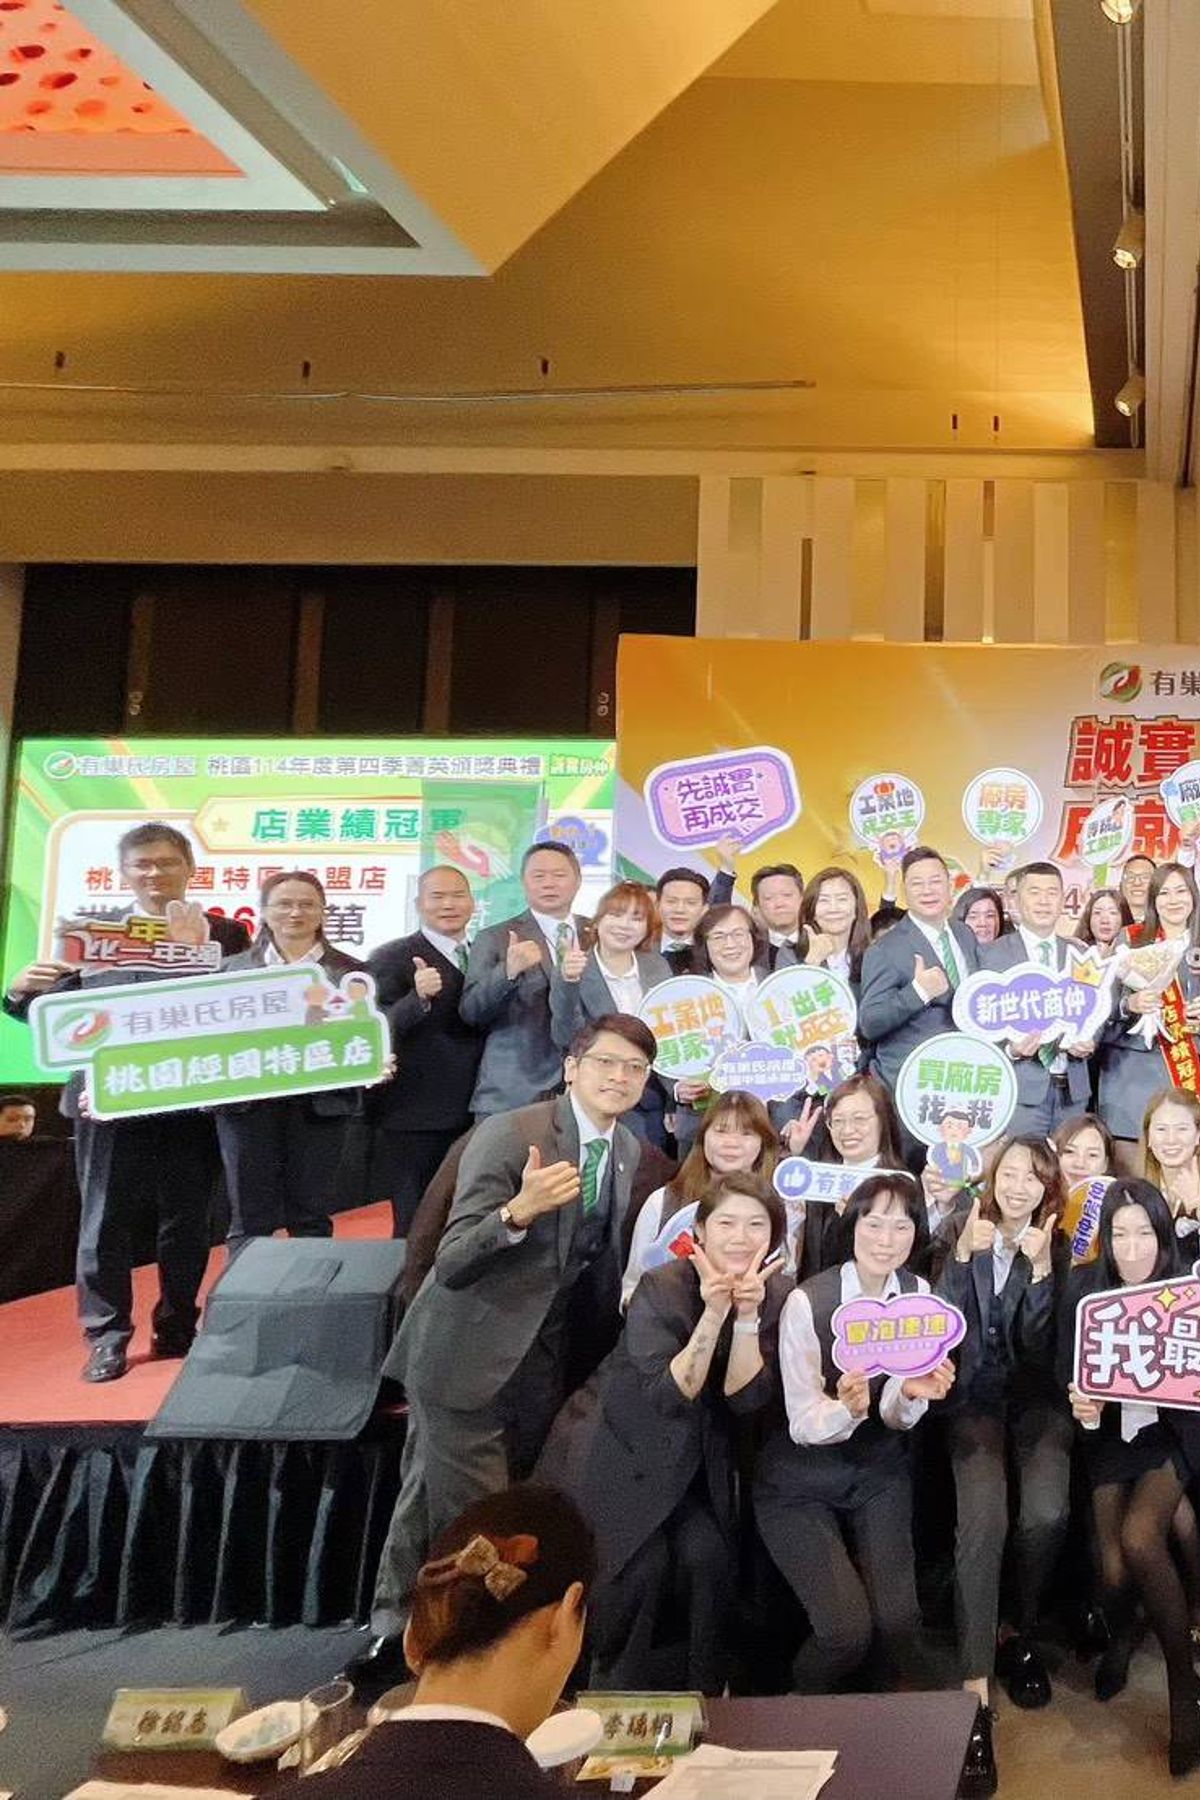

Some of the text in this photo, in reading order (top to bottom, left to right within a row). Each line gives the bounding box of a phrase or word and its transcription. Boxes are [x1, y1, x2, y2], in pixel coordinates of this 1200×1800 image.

[681, 788, 763, 831] 再成交
[121, 989, 291, 1036] 有巢氏房屋
[977, 986, 1086, 1025] 新世代商仲
[105, 1036, 374, 1096] 桃園經國特區店
[917, 1059, 1003, 1096] 買廠房
[917, 1094, 994, 1130] 找我
